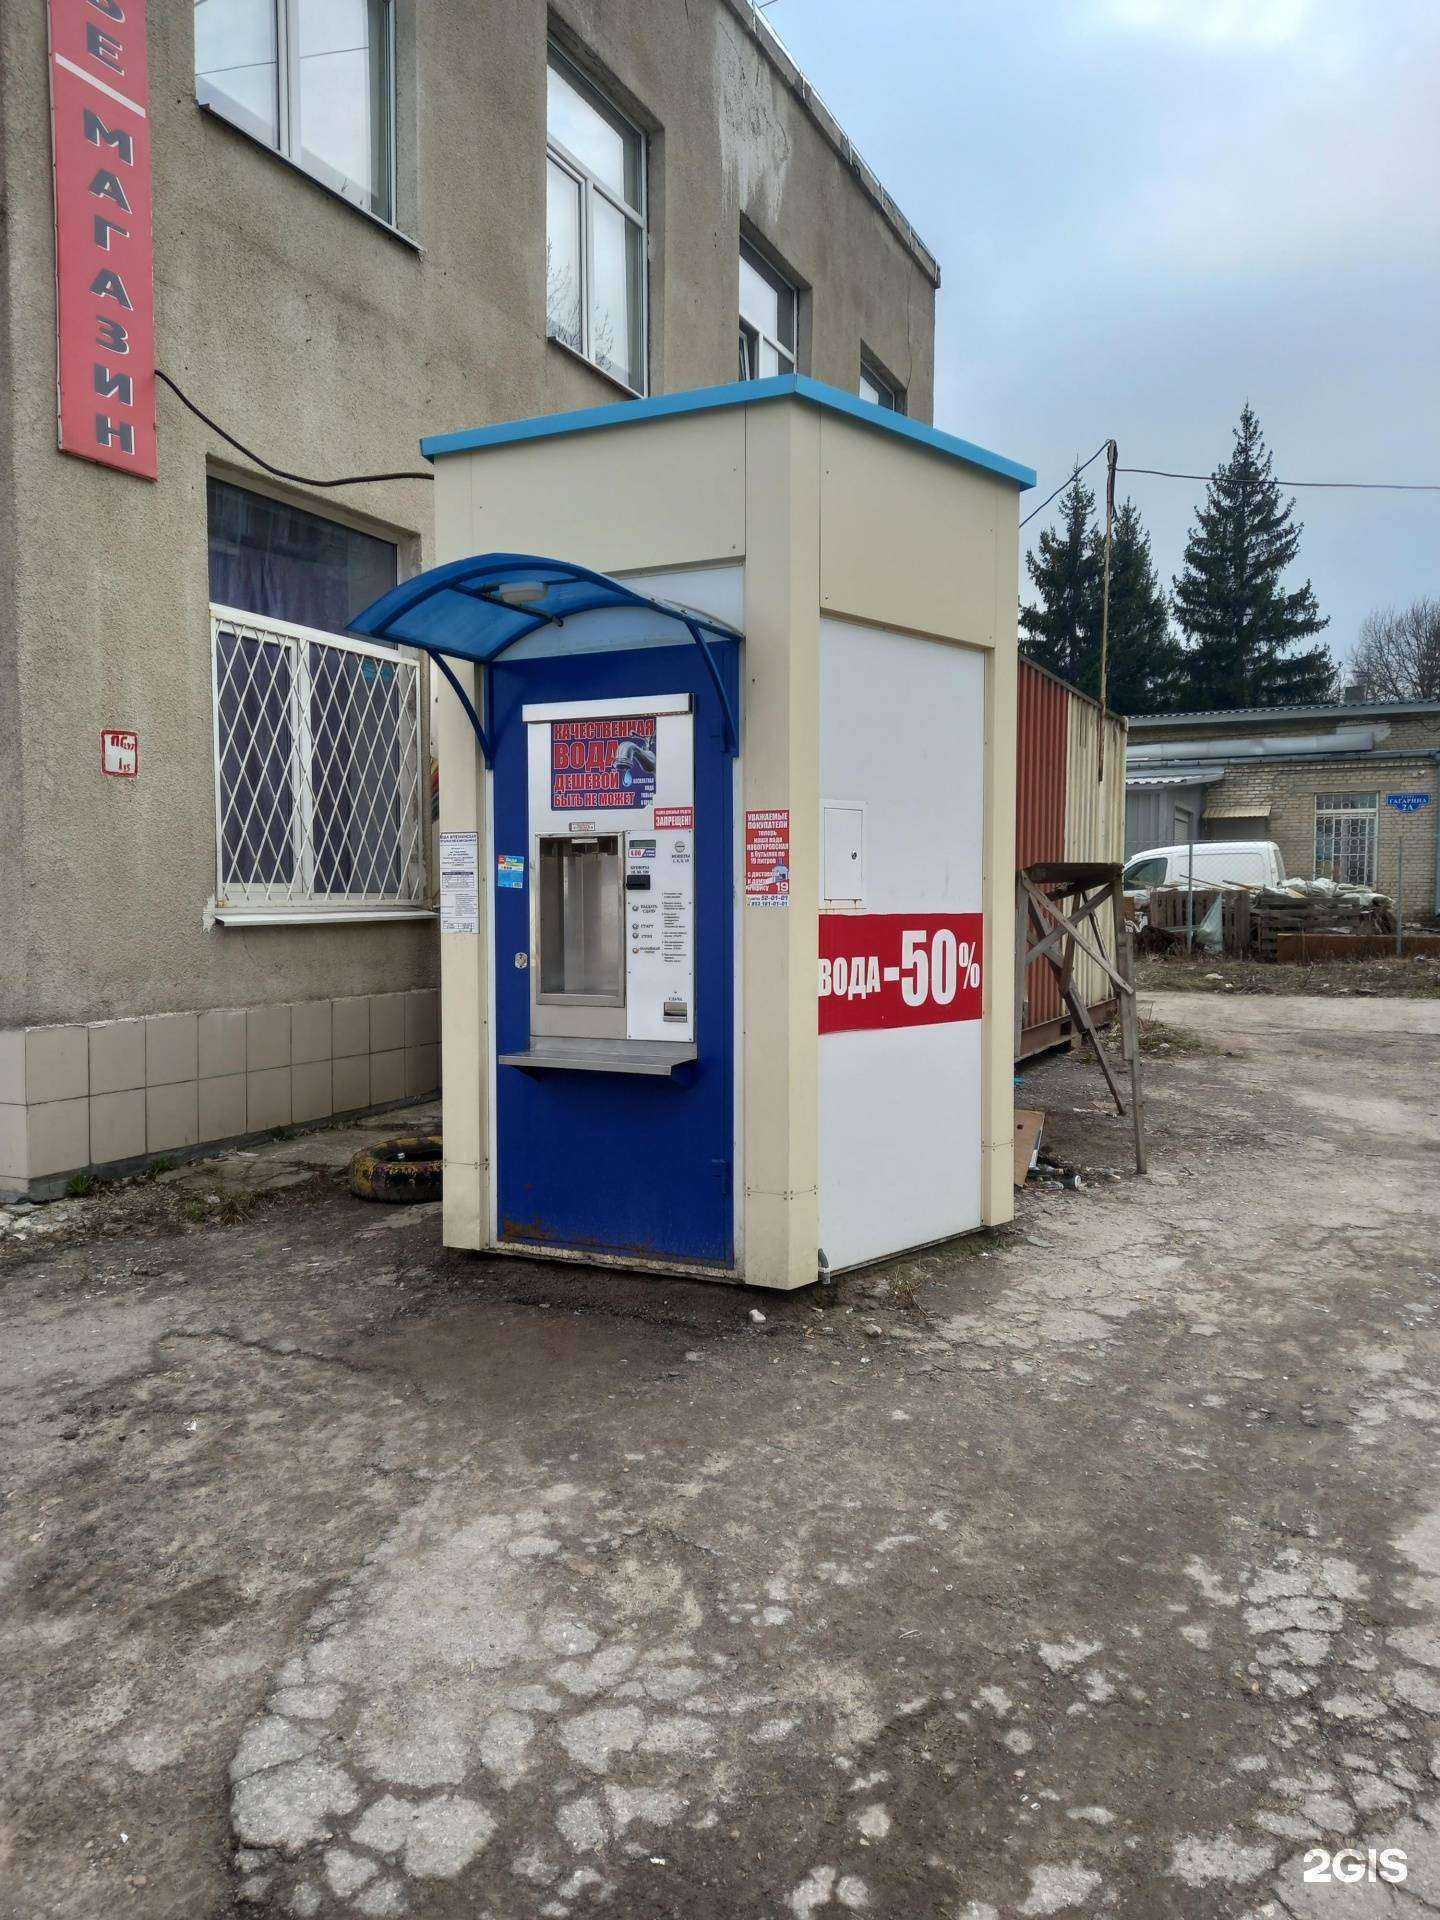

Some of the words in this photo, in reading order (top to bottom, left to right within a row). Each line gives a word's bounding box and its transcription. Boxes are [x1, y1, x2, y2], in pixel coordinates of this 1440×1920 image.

[83, 108, 135, 455] МАГАЗИН
[554, 719, 655, 741] КАЧЕСТВЕННАЯ
[553, 740, 619, 772] ВОДА
[554, 770, 620, 793] ДЕШЕВОЙ
[554, 794, 585, 807] БЫТЬ
[585, 792, 598, 806] НЕ
[598, 791, 635, 806] МОЖЕТ
[655, 814, 692, 827] ЗАПРЕЩЕН!
[747, 812, 788, 822] УВАЖАЕМЫЕ
[747, 820, 788, 829] ПОКУПАТЕЛИ
[816, 956, 881, 1000] ВОДА
[883, 928, 981, 1007] -50%
